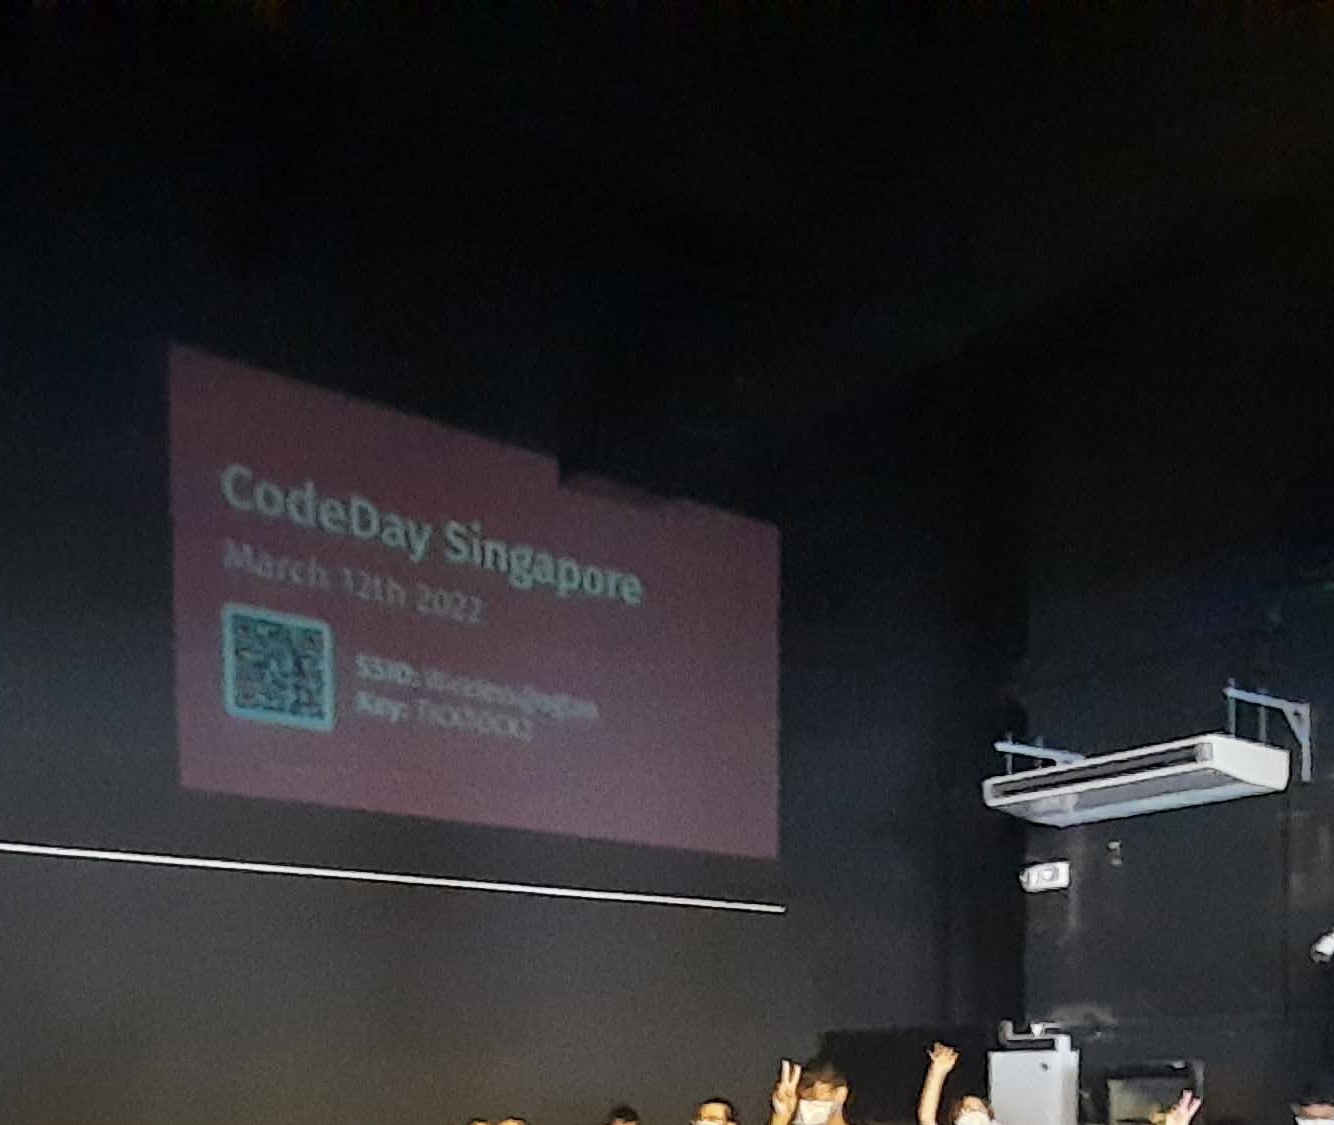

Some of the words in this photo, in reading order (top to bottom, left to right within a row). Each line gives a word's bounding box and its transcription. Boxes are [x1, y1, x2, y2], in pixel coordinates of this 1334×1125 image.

[220, 464, 433, 562] CodeDay
[444, 518, 645, 604] Singapore
[222, 537, 330, 590] March
[342, 564, 407, 607] 12th
[416, 586, 485, 625] 2022
